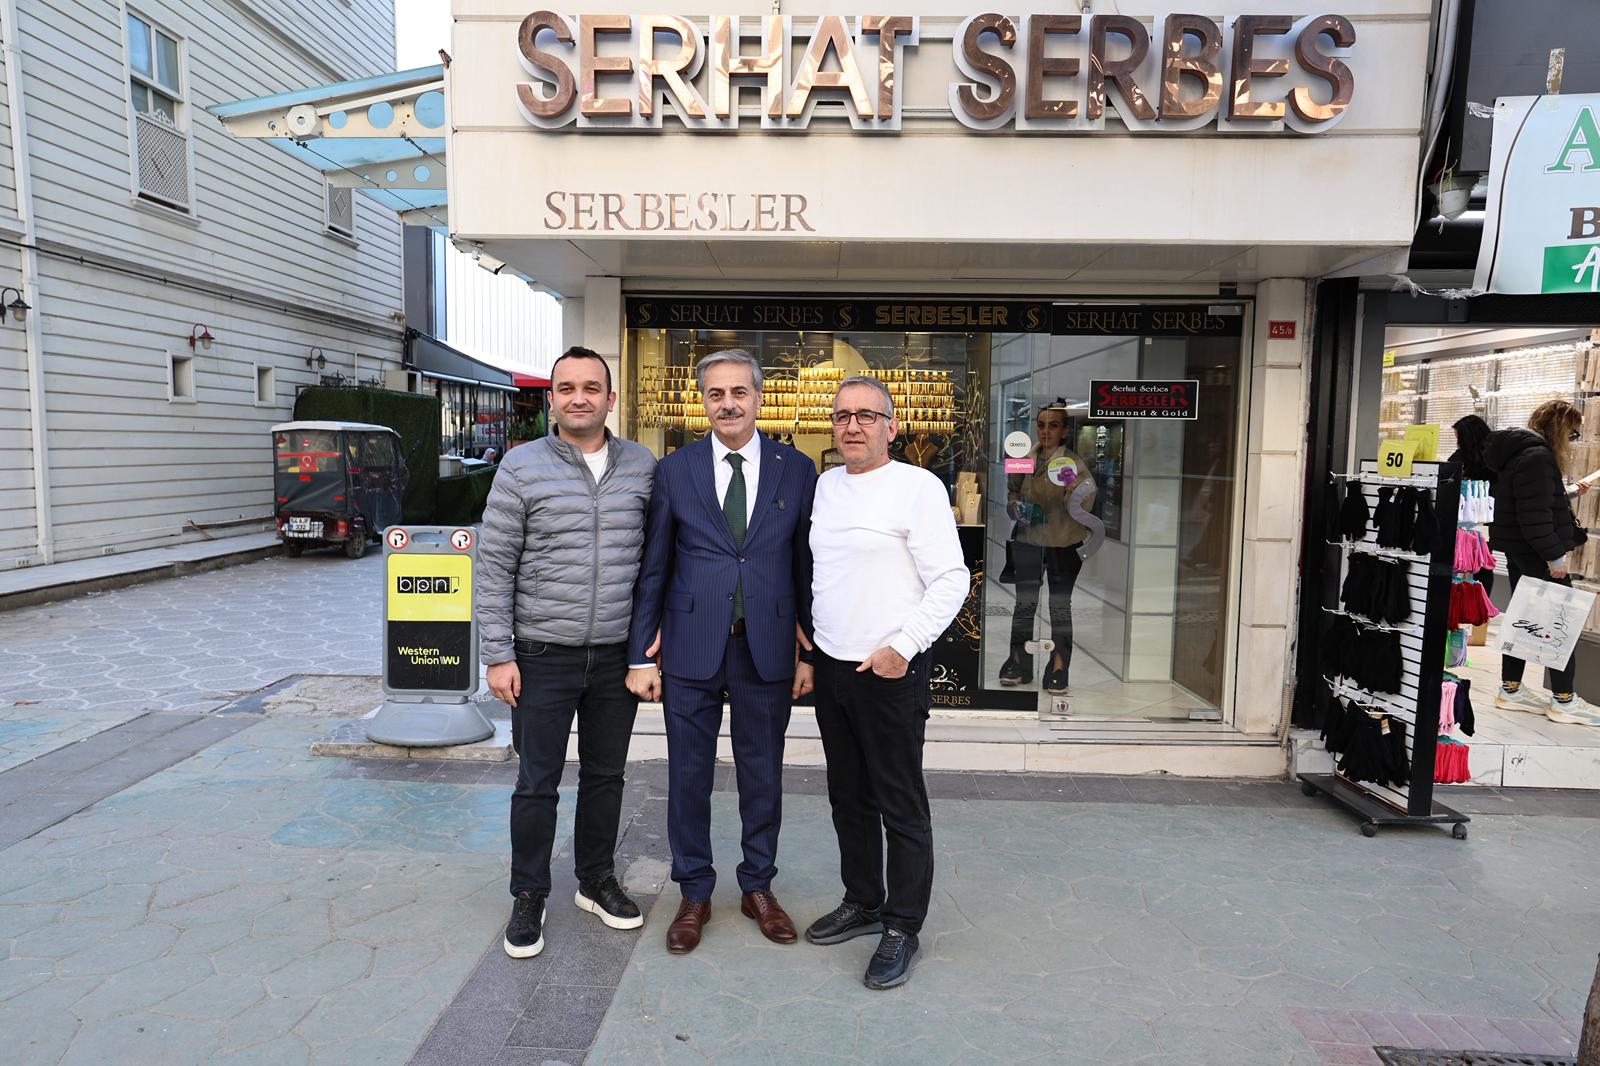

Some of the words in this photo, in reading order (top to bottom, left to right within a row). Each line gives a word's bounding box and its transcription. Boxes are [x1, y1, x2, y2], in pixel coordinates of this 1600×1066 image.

[516, 10, 914, 121] SERHAT
[957, 12, 1357, 123] SERBES
[543, 190, 817, 232] SERBESLER
[670, 304, 744, 326] SERHAT
[753, 306, 824, 328] SERBES
[875, 305, 1008, 325] SERBESLER
[1066, 311, 1143, 333] SERHAT
[1152, 311, 1226, 334] SERBES
[1096, 409, 1147, 417] Diamond
[1161, 409, 1189, 417] Gold
[1386, 452, 1404, 468] 50
[397, 646, 440, 655] Western
[411, 655, 439, 665] Union
[931, 694, 971, 706] SERBES
